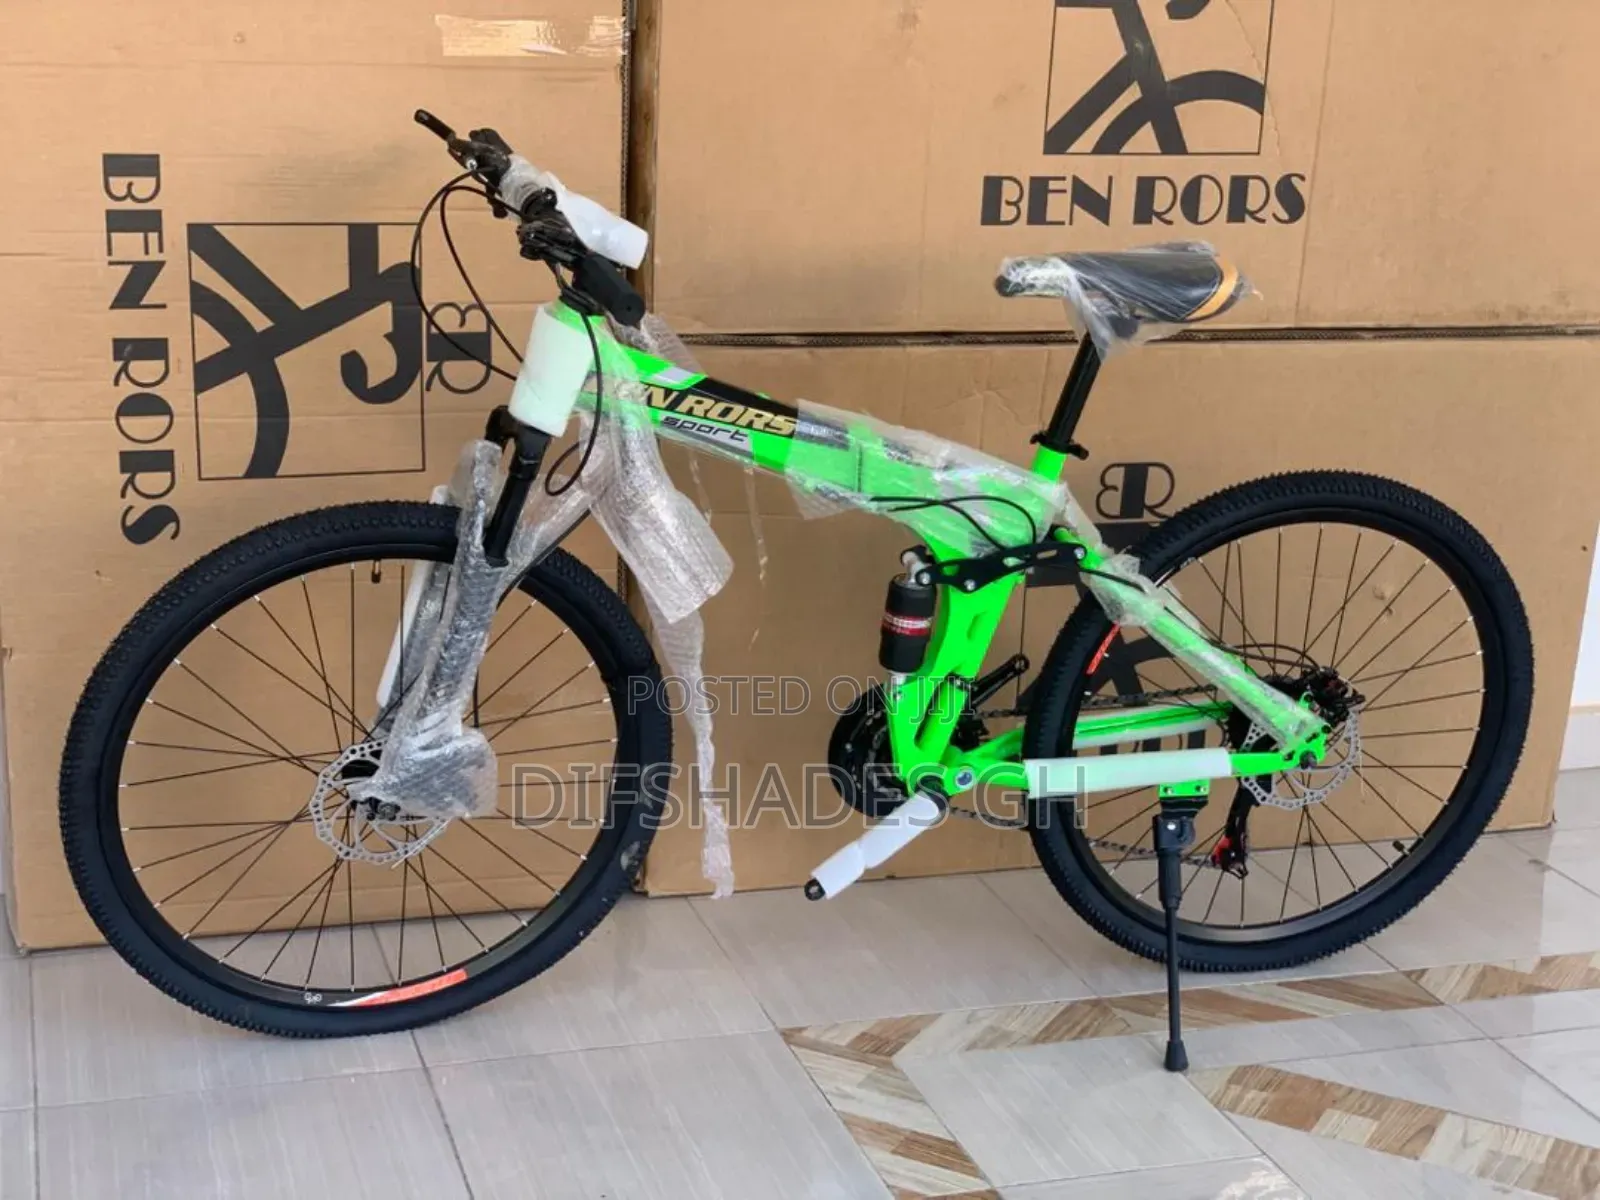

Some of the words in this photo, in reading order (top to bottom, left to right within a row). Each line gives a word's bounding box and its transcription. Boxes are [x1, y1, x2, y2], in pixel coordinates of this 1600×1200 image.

[980, 174, 1114, 227] BEN
[1132, 172, 1306, 226] RORS
[102, 153, 167, 309] BEN
[112, 337, 181, 545] RORS
[661, 415, 750, 443] sport
[674, 394, 797, 437] RORS
